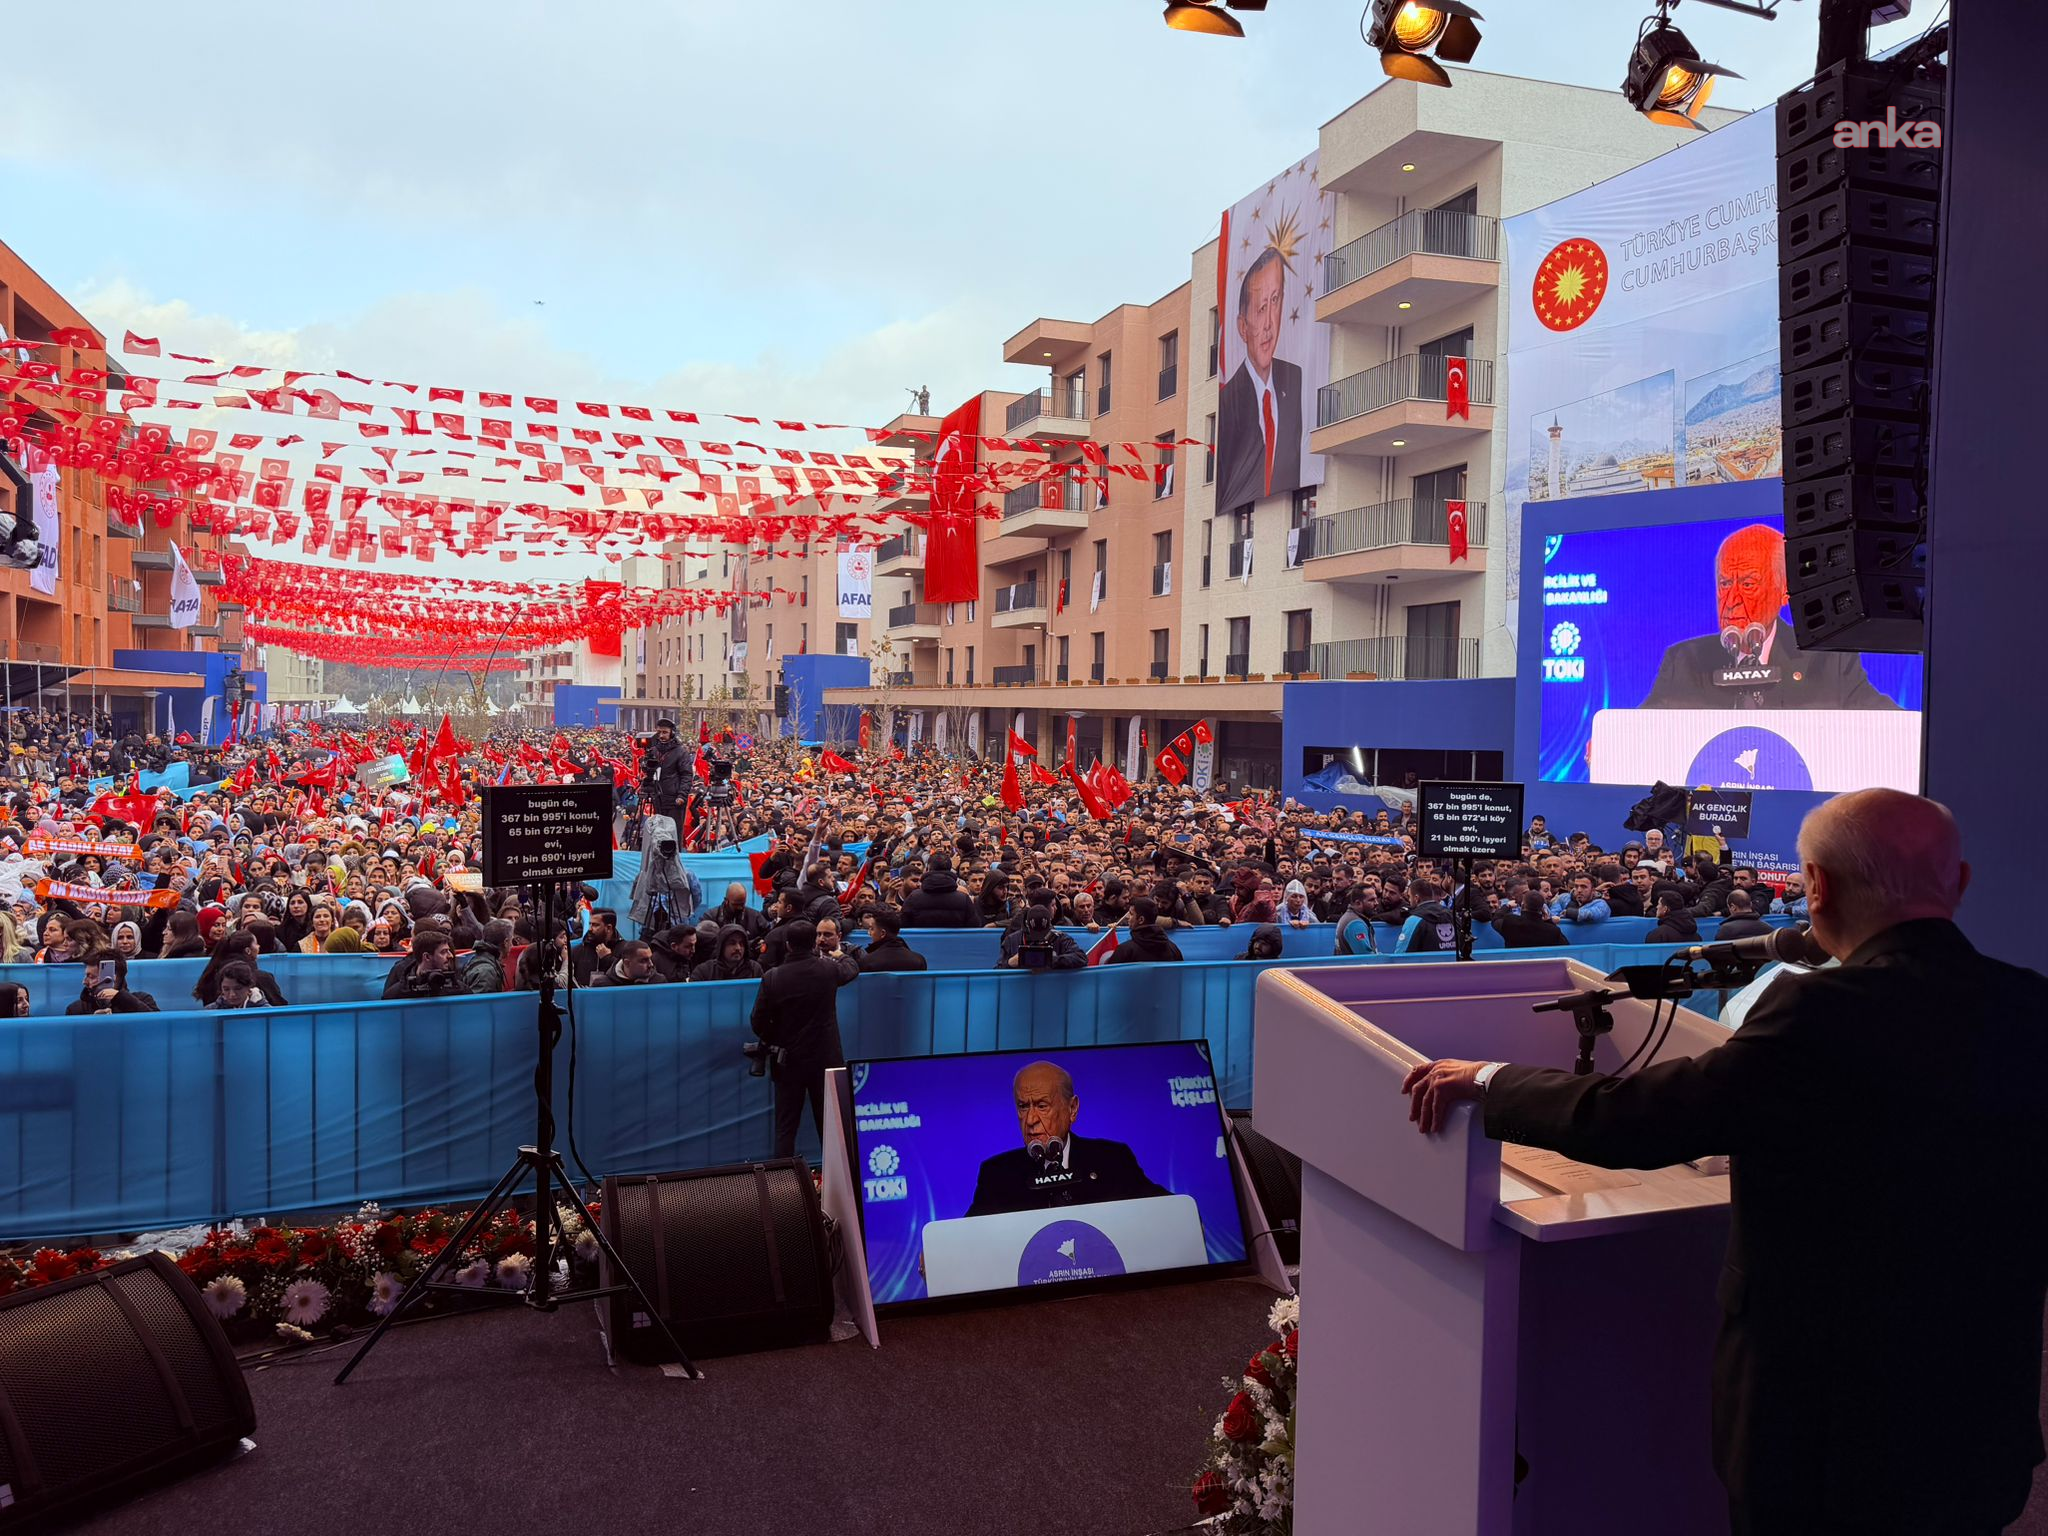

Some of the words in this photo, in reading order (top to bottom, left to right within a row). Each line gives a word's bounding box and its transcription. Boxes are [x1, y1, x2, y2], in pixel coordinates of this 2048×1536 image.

[1620, 214, 1701, 261] TÜRKİYE
[1723, 670, 1771, 680] HATAY
[1450, 793, 1477, 802] bugün
[528, 800, 559, 809] bugün
[562, 799, 577, 808] de,
[1461, 803, 1482, 811] 995'i
[1484, 804, 1512, 813] konut,
[1692, 803, 1705, 811] AK
[1707, 804, 1747, 813] GENÇLİK
[501, 815, 520, 823] 367
[523, 814, 540, 822] bin
[542, 812, 567, 821] 995'i
[569, 812, 600, 822] konut,
[1490, 815, 1506, 824] köy
[1699, 813, 1737, 822] BURADA
[509, 828, 521, 836] 65
[525, 827, 541, 836] bin
[543, 826, 573, 835] 672'si
[576, 825, 593, 835] köy
[1462, 825, 1478, 833] evi,
[544, 840, 562, 849] evi,
[1482, 836, 1506, 844] işyeri
[1443, 845, 1470, 853] olmak
[507, 855, 519, 864] 21
[523, 854, 539, 864] bin
[568, 851, 595, 863] işyeri
[1748, 851, 1778, 862] İNŞASI
[1757, 861, 1799, 871] BAŞARISI
[522, 868, 553, 877] olmak
[556, 866, 584, 876] üzere
[1035, 1172, 1073, 1184] HATAY
[1048, 1269, 1070, 1279] ASRIN
